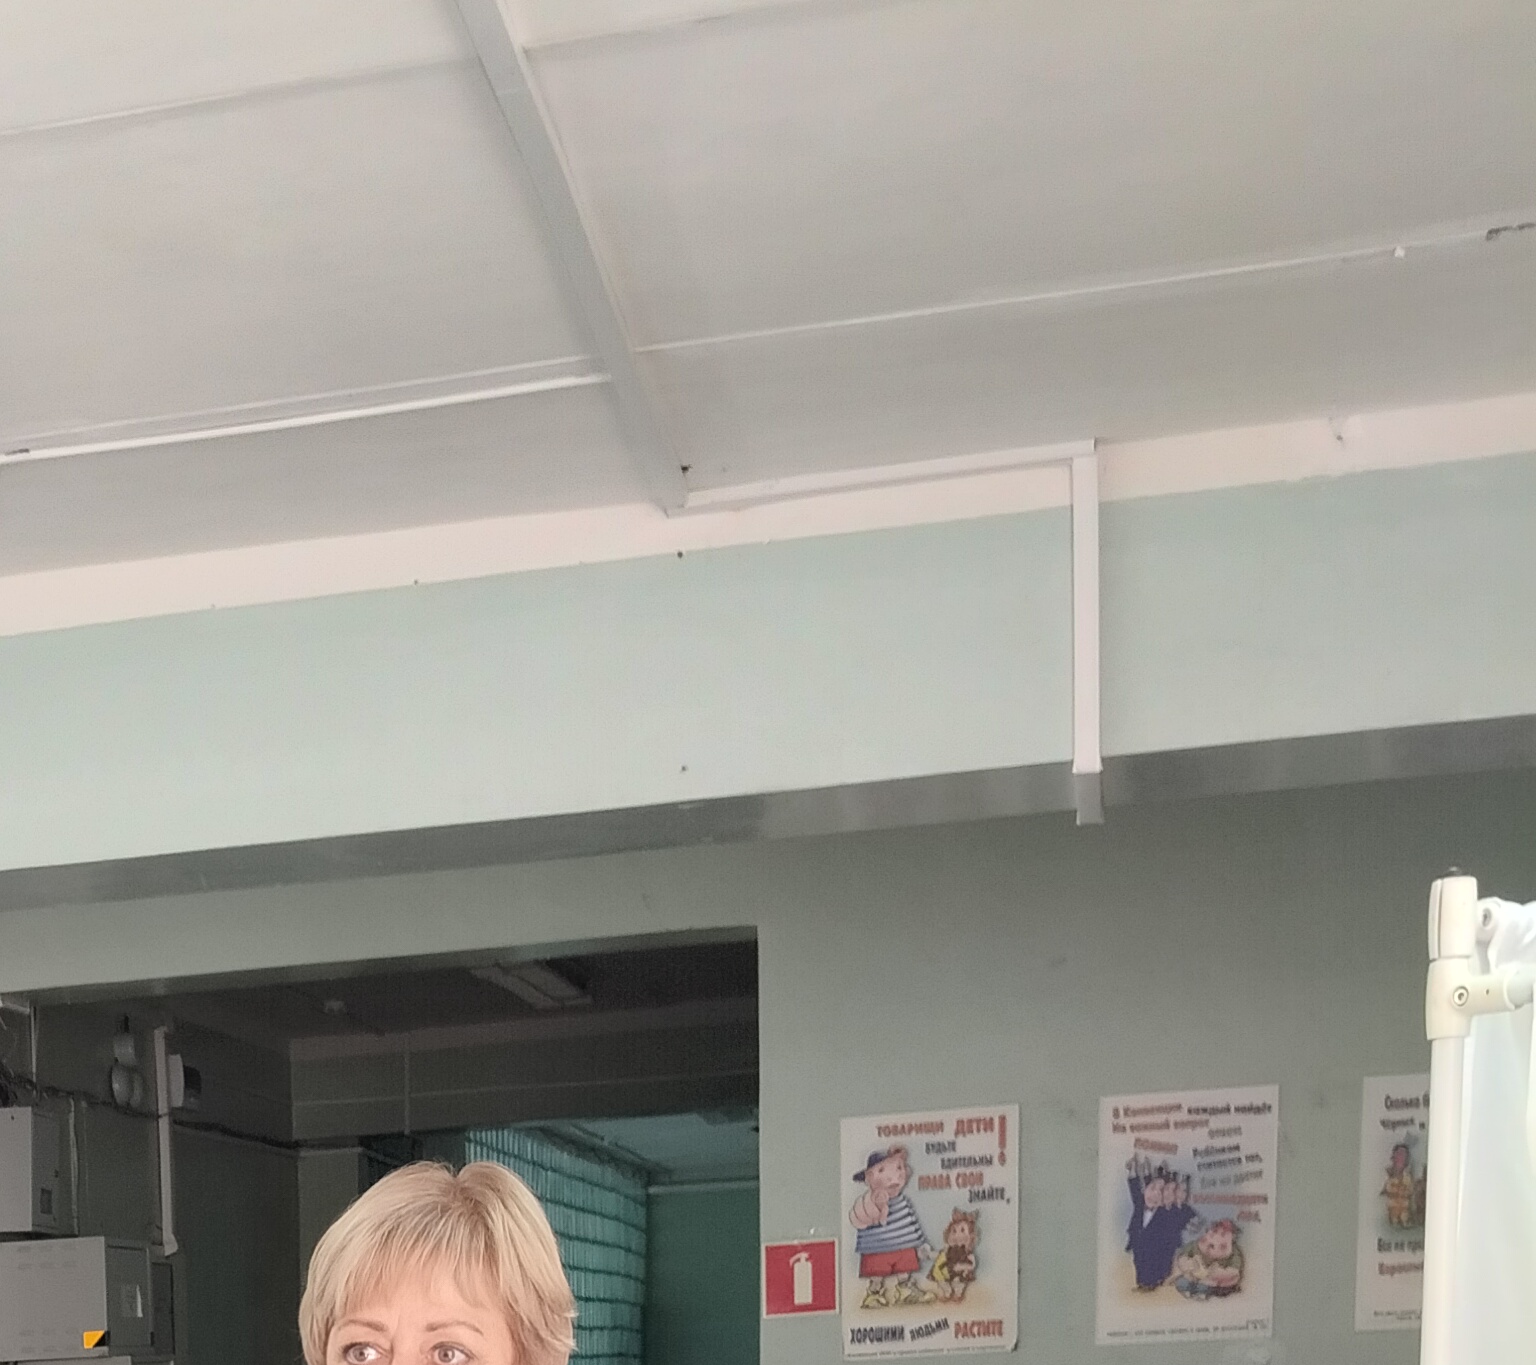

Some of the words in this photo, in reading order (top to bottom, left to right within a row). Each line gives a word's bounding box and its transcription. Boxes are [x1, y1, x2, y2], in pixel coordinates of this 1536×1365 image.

[875, 1120, 945, 1138] ТОВАРИЩИ
[925, 1139, 957, 1155] БУДЬТЕ
[940, 1154, 994, 1170] БДИТЕЛЬНЫ
[917, 1173, 952, 1191] ПРАВА
[955, 1170, 984, 1189] СВОИ
[849, 1325, 905, 1345] ХОРОШИМИ
[909, 1317, 951, 1342] ЛЮДЬМИ
[954, 1319, 1004, 1340] РАСТИТЕ
